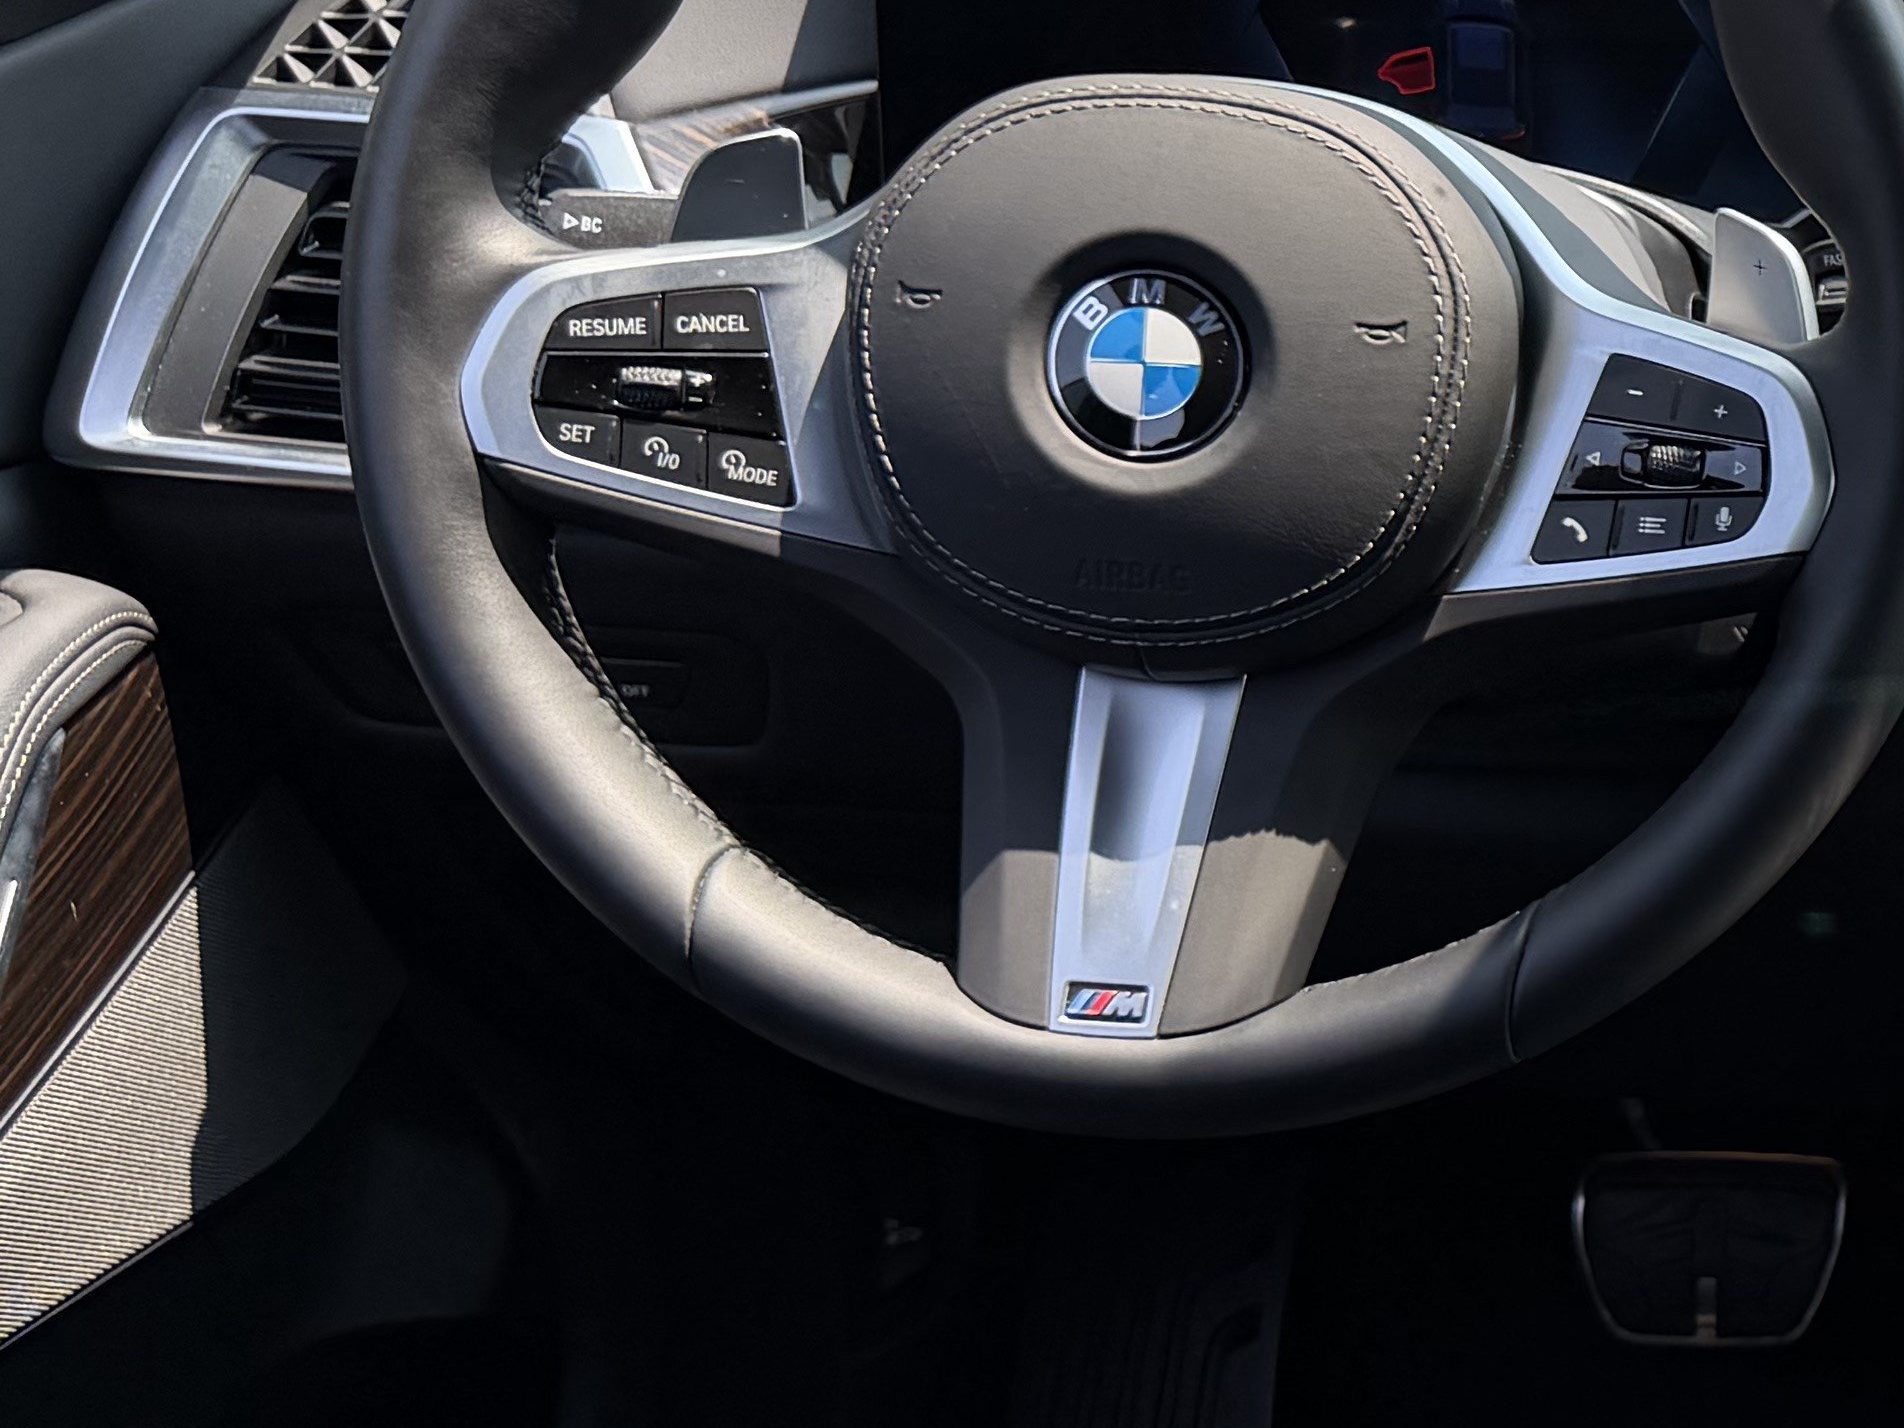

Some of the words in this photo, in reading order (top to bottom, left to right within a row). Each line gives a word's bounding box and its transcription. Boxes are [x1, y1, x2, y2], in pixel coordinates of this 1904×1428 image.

[581, 215, 603, 233] BC
[568, 316, 647, 338] RESUME
[676, 314, 750, 334] CANCEL
[1073, 277, 1225, 337] BMW
[558, 423, 597, 444] SET
[657, 450, 680, 470] I/O
[726, 462, 779, 487] MODE
